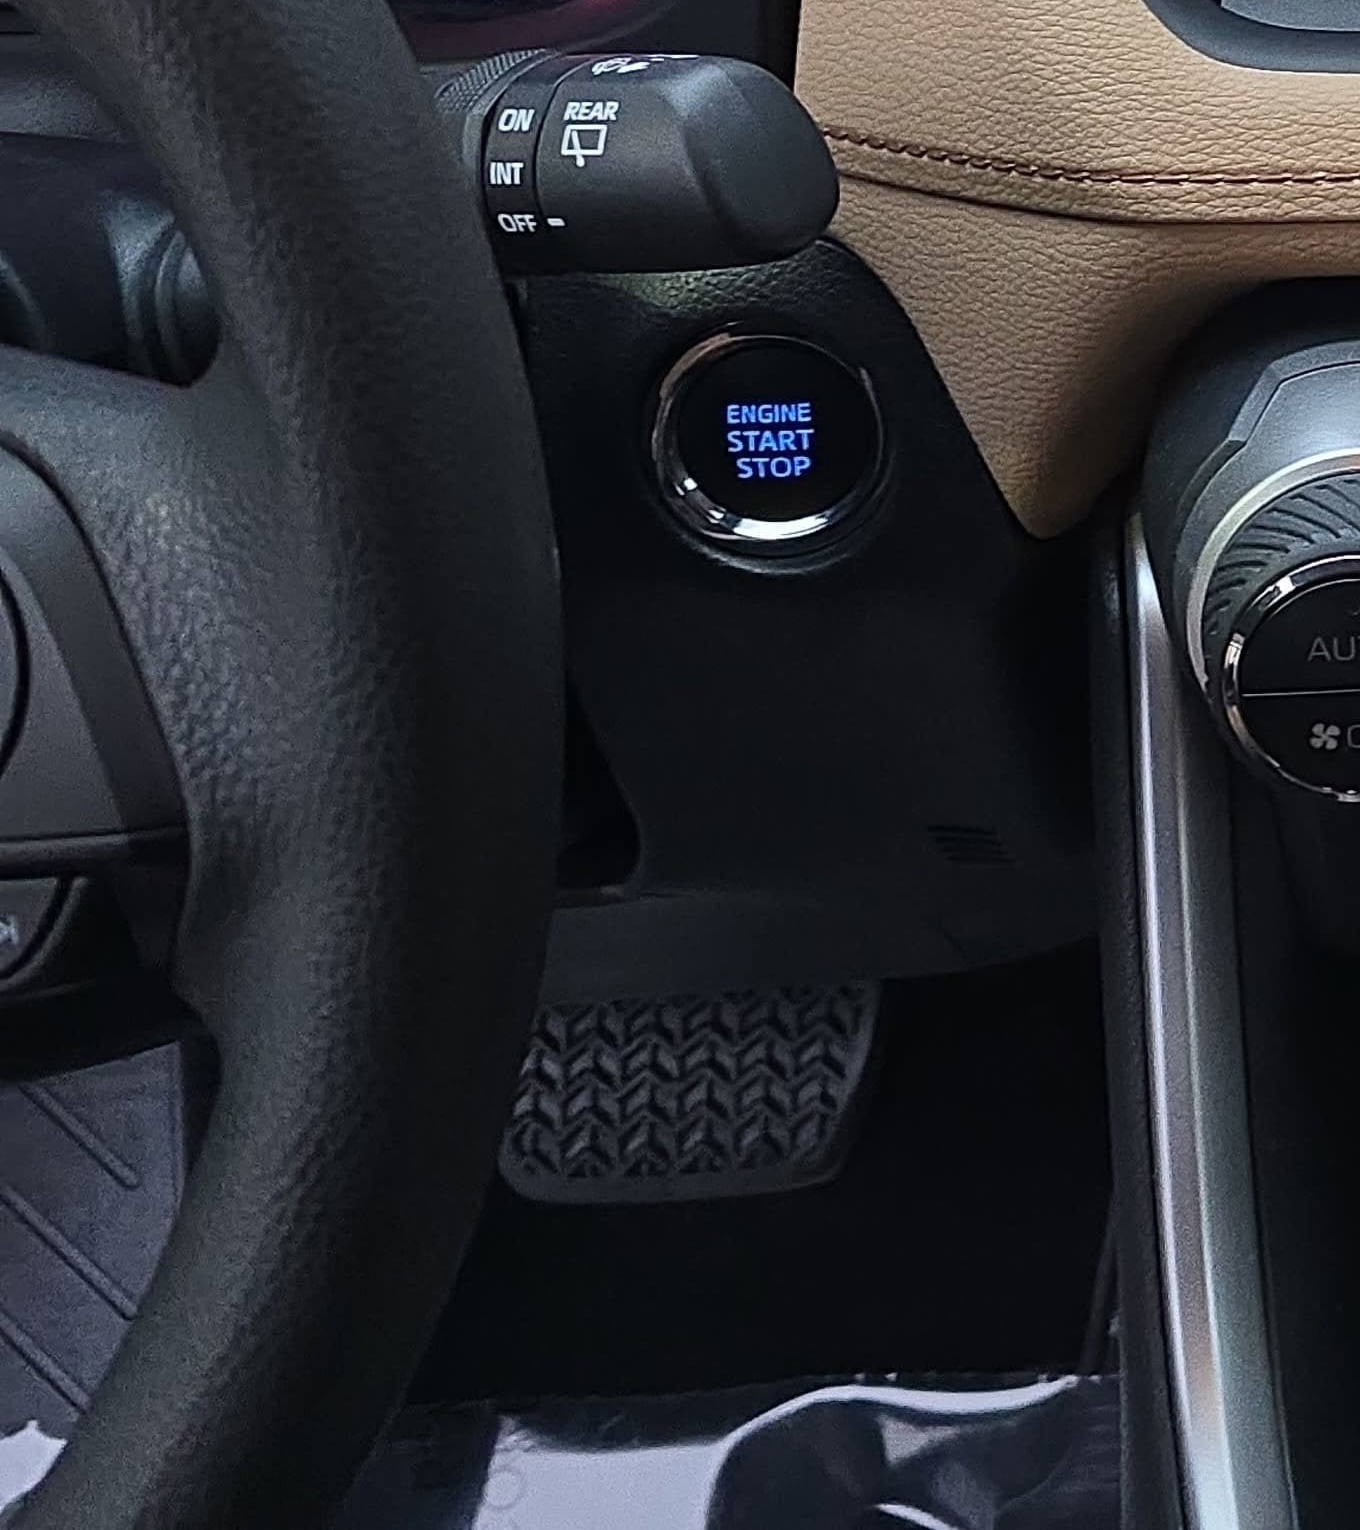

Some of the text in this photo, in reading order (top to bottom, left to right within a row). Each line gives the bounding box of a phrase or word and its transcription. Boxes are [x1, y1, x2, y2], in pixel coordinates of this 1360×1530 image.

[498, 108, 535, 132] ON
[563, 101, 619, 121] REAR
[489, 161, 524, 185] INT
[497, 213, 537, 232] OFF
[726, 402, 812, 424] ENGINE
[727, 428, 815, 452] START
[736, 455, 811, 479] STOP
